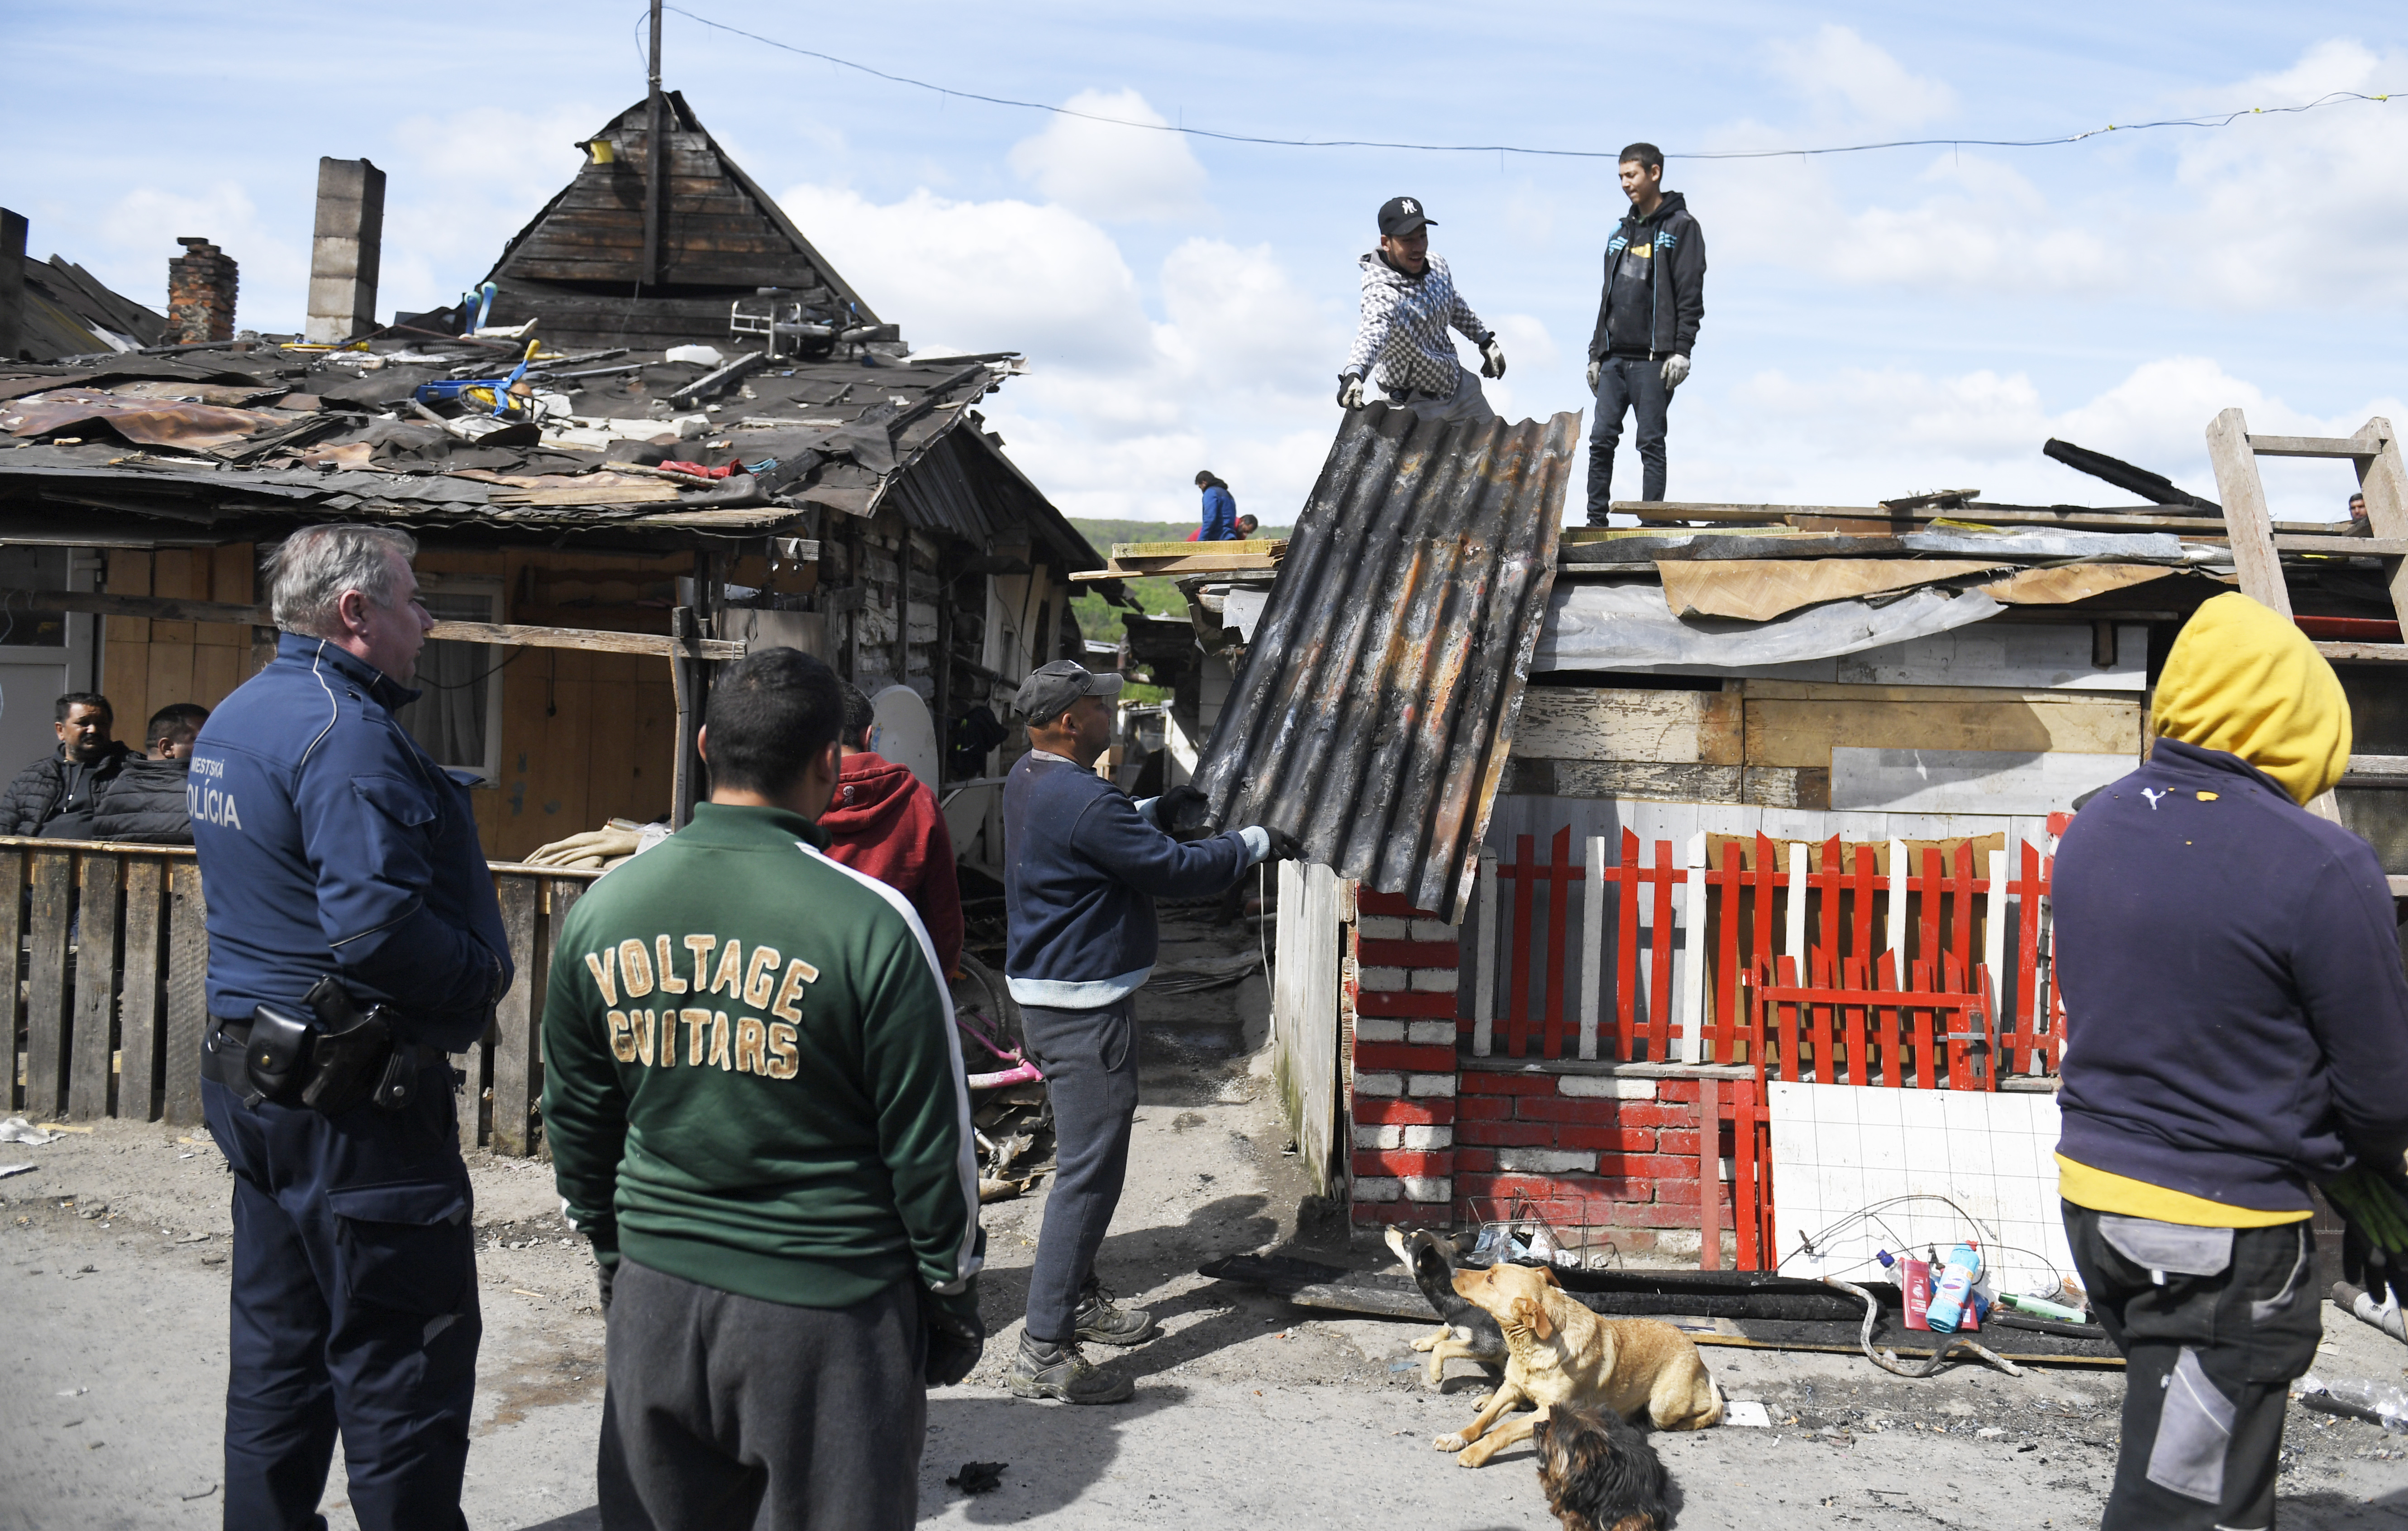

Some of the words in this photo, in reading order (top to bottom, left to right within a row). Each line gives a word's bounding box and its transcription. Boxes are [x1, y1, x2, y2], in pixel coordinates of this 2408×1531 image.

[191, 757, 225, 779] MESTSKÁ
[186, 778, 242, 830] OLÍCIA
[584, 934, 820, 1025] VOLTAGE
[606, 1008, 799, 1080] GUITARS
